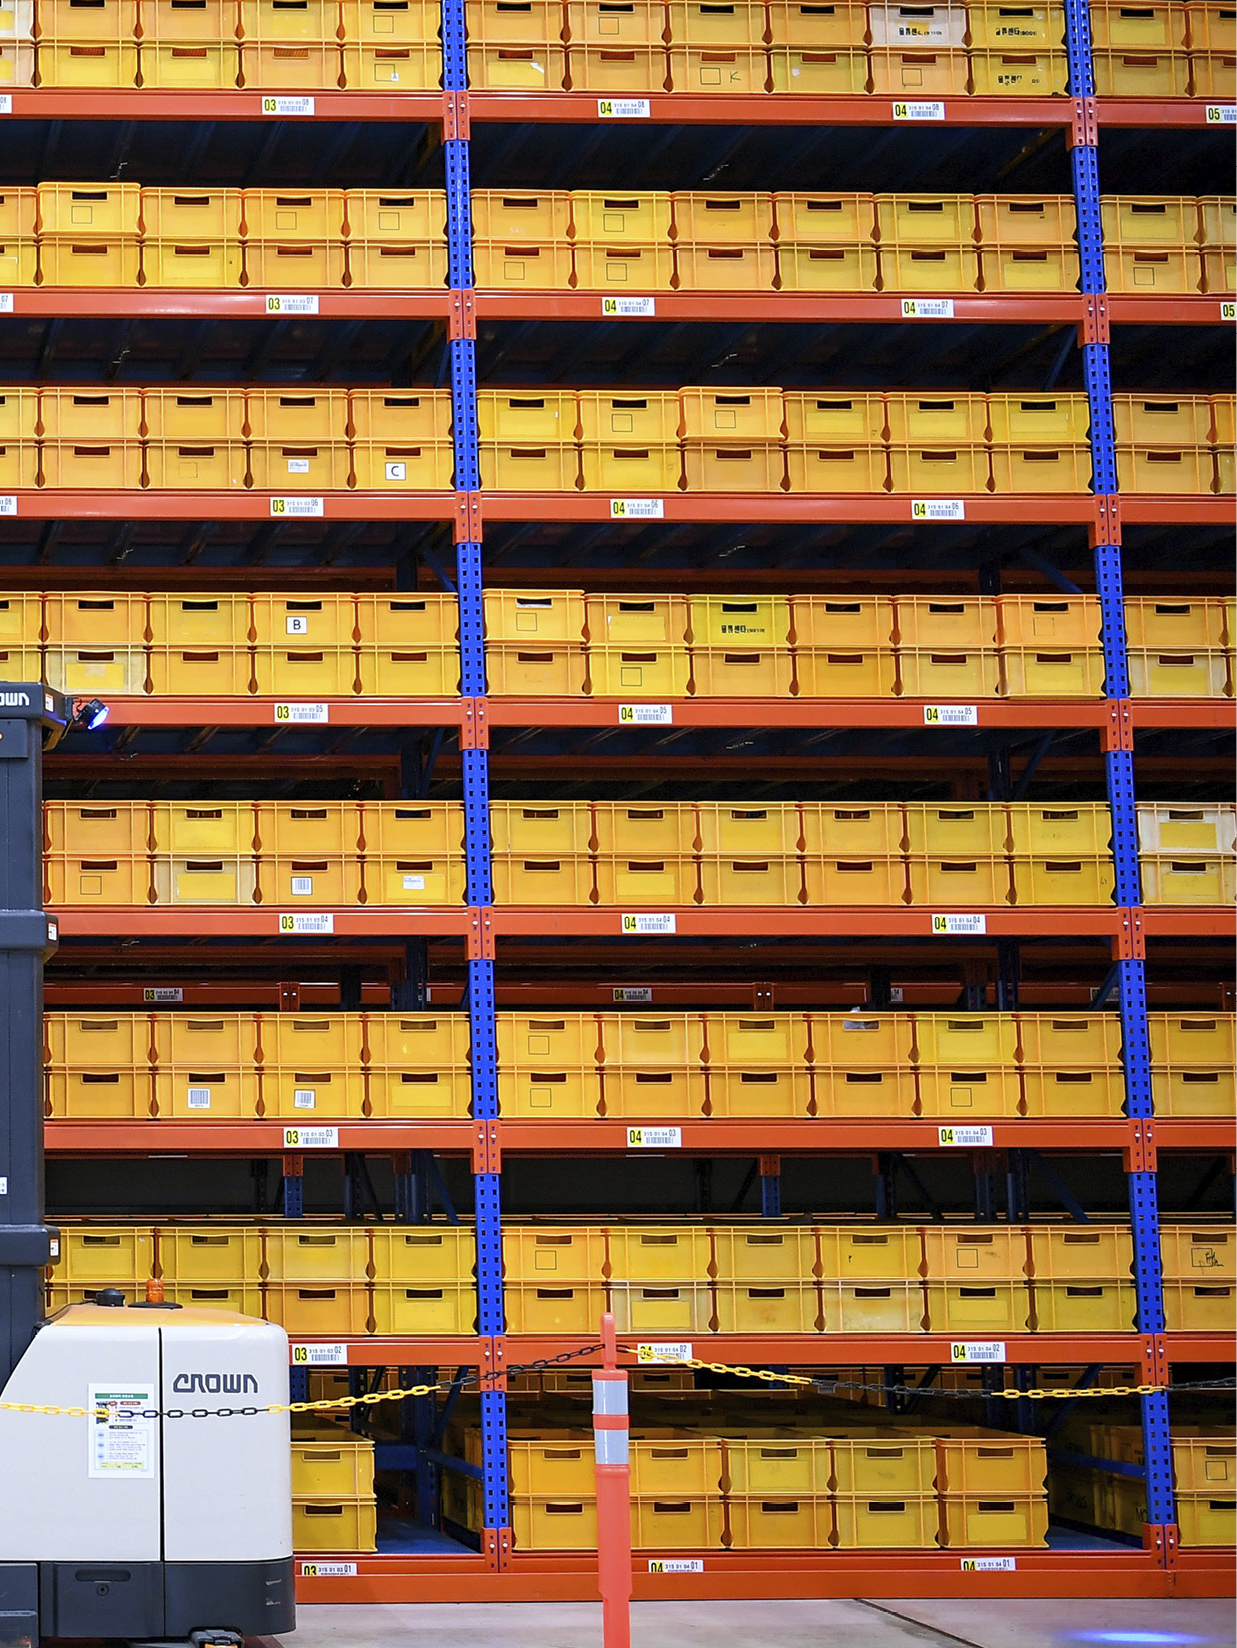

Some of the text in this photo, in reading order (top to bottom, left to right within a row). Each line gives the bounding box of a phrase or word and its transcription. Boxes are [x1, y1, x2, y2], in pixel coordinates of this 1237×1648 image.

[265, 99, 276, 111] 03
[600, 102, 612, 114] 04
[895, 105, 907, 116] 04
[1208, 108, 1220, 120] 05
[268, 298, 280, 310] 03
[605, 300, 616, 312] 04
[904, 302, 915, 314] 04
[1223, 305, 1235, 317] 05
[391, 466, 399, 476] C
[273, 500, 285, 512] 03
[613, 502, 625, 514] 04
[914, 503, 926, 515] 04
[293, 620, 301, 630] B
[277, 706, 289, 718] 03
[621, 707, 633, 720] 04
[927, 708, 938, 720] 04
[282, 916, 294, 929] 03
[321, 915, 329, 923] 04
[625, 917, 636, 929] 04
[935, 917, 946, 930] 04
[973, 916, 981, 924] 04
[146, 990, 155, 1000] 03
[615, 990, 624, 1000] 04
[286, 1131, 298, 1144] 03
[630, 1130, 642, 1143] 04
[669, 1129, 677, 1137] 03
[941, 1129, 953, 1142] 04
[980, 1128, 988, 1136] 03
[295, 1347, 307, 1361] 03
[335, 1346, 343, 1354] 02
[680, 1344, 688, 1352] 02
[954, 1345, 966, 1358] 04
[994, 1344, 1002, 1352] 02
[173, 1374, 258, 1393] CROWN
[344, 1563, 352, 1571] 01
[651, 1562, 663, 1571] 04
[691, 1560, 699, 1568] 01
[963, 1561, 976, 1569] 04
[1003, 1558, 1011, 1566] 01
[304, 1565, 316, 1575] 03
